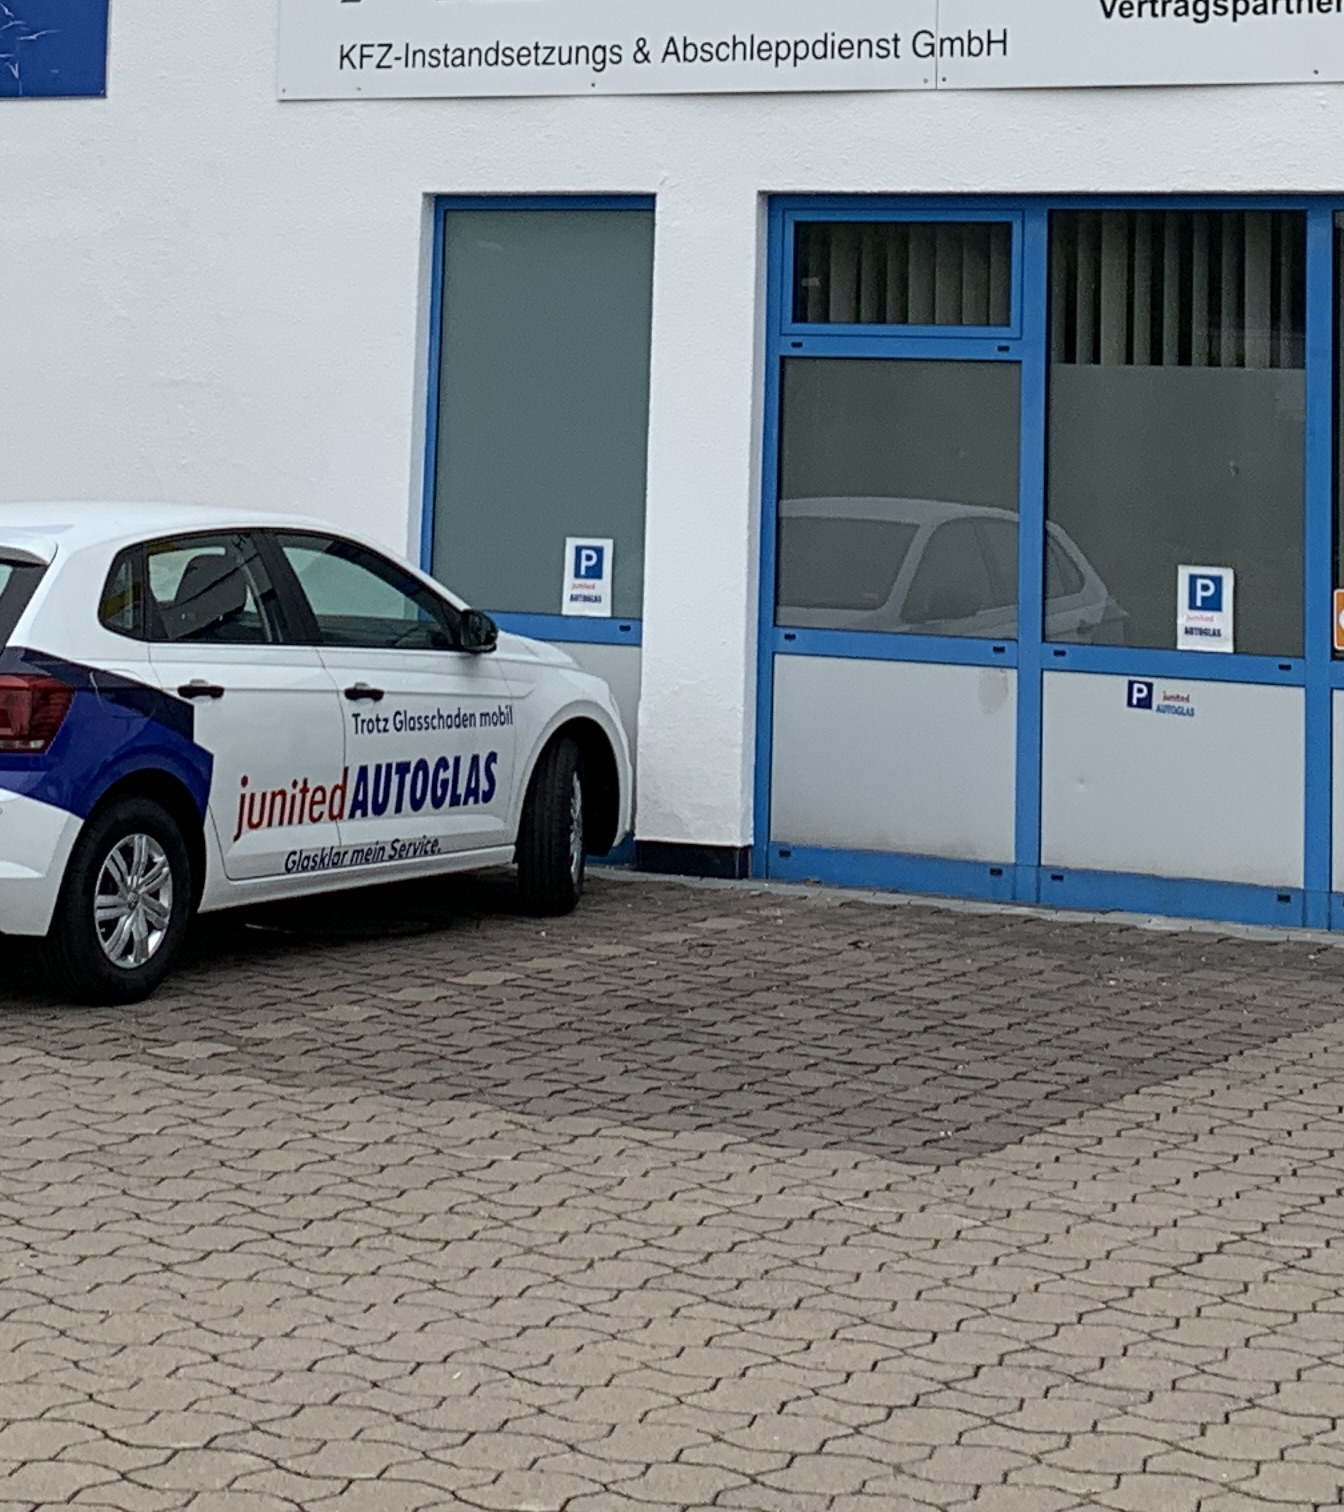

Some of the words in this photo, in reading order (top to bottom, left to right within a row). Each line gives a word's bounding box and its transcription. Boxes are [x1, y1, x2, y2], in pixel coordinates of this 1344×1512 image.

[338, 39, 624, 72] KFZ-Instandsetzungs
[632, 39, 652, 64] &
[661, 34, 901, 67] Abschleppdienst
[911, 29, 1008, 59] GmbH
[352, 712, 389, 736] Trotz
[393, 707, 476, 733] Glasschaden
[479, 705, 513, 727] mobil
[233, 766, 349, 842] junited
[348, 751, 498, 819] AUTOGLAS
[285, 847, 348, 873] Glasklar
[351, 842, 385, 865] mein
[387, 837, 442, 860] Service.
